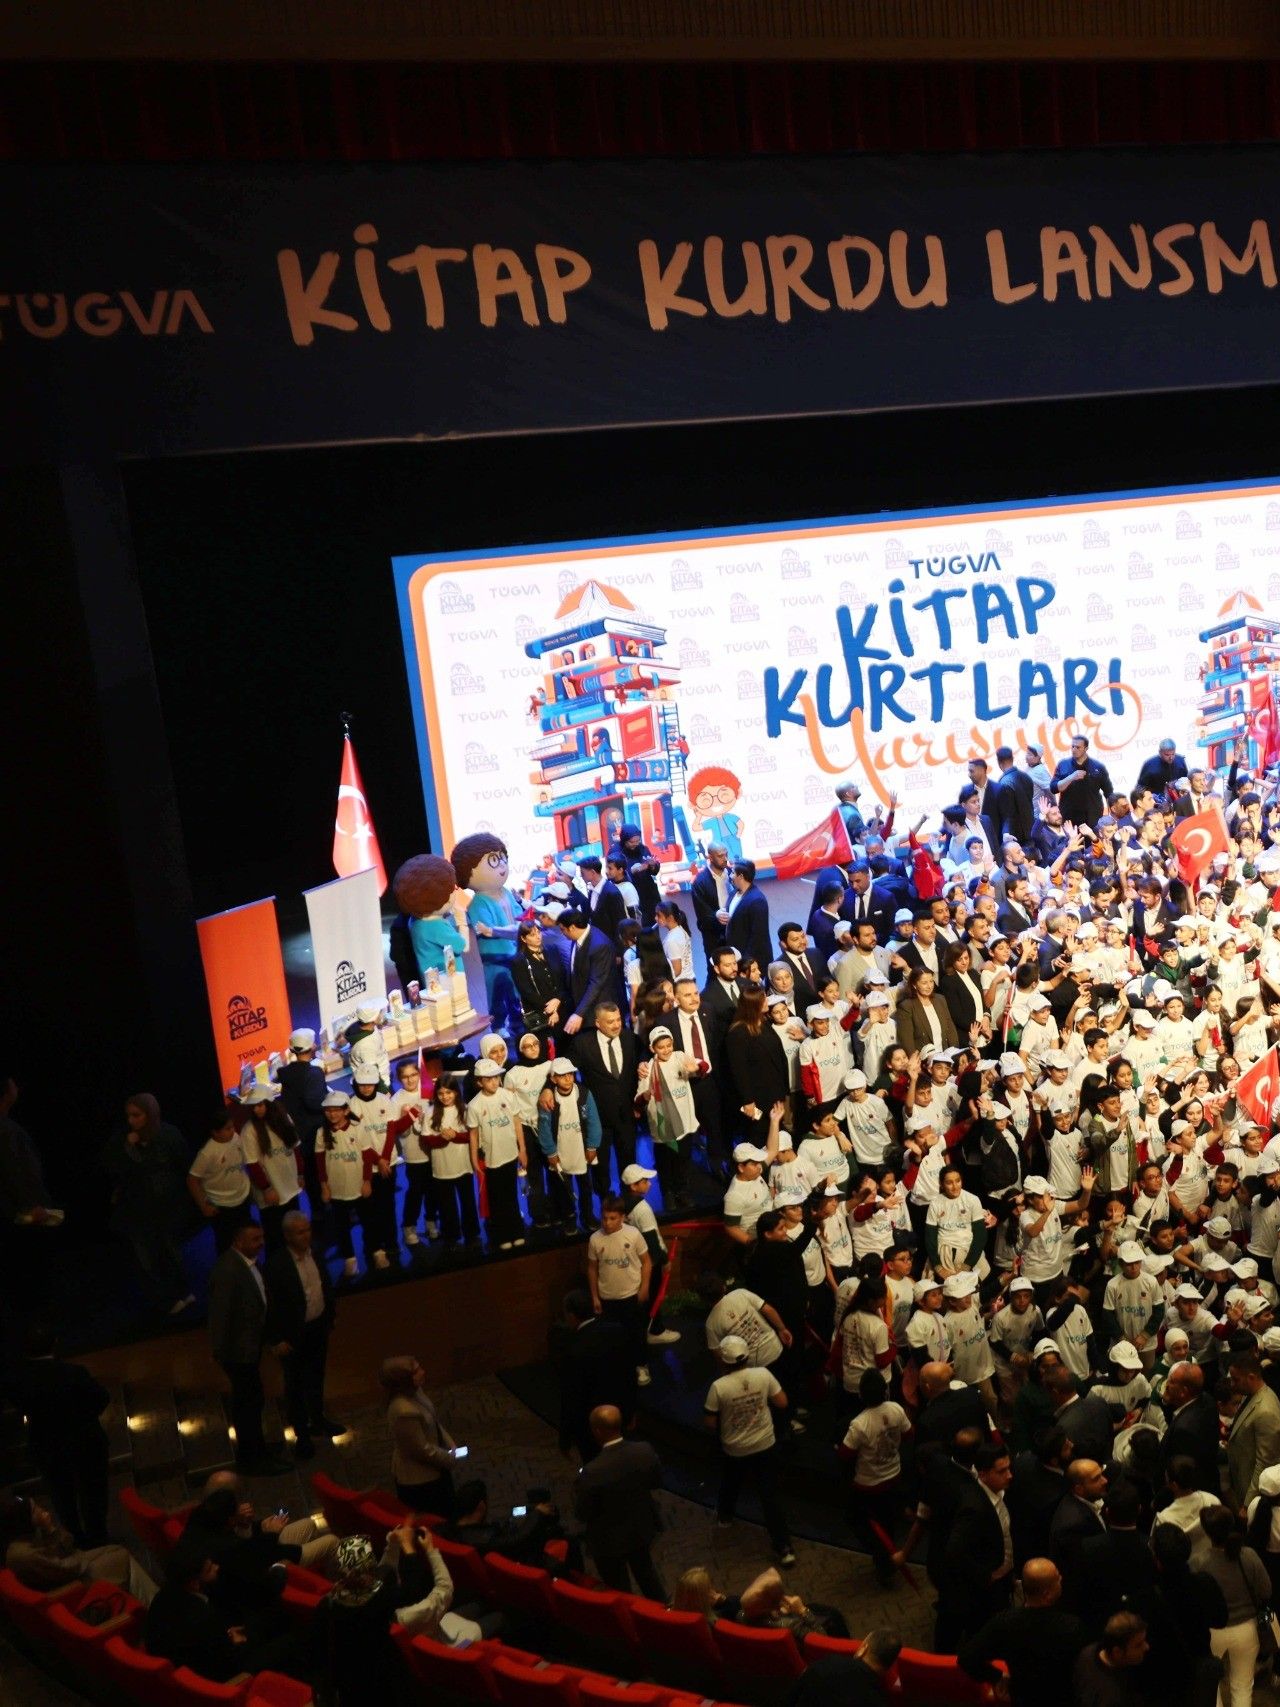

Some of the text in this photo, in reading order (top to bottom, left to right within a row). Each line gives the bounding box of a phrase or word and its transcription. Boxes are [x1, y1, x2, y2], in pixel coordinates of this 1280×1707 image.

[0, 289, 215, 341] ÜGVA
[277, 222, 592, 346] KİTAP
[638, 229, 948, 331] KURDU
[908, 551, 1002, 580] TÜGVA
[836, 577, 1056, 664] KİTAP
[764, 657, 1125, 738] KURTLARI
